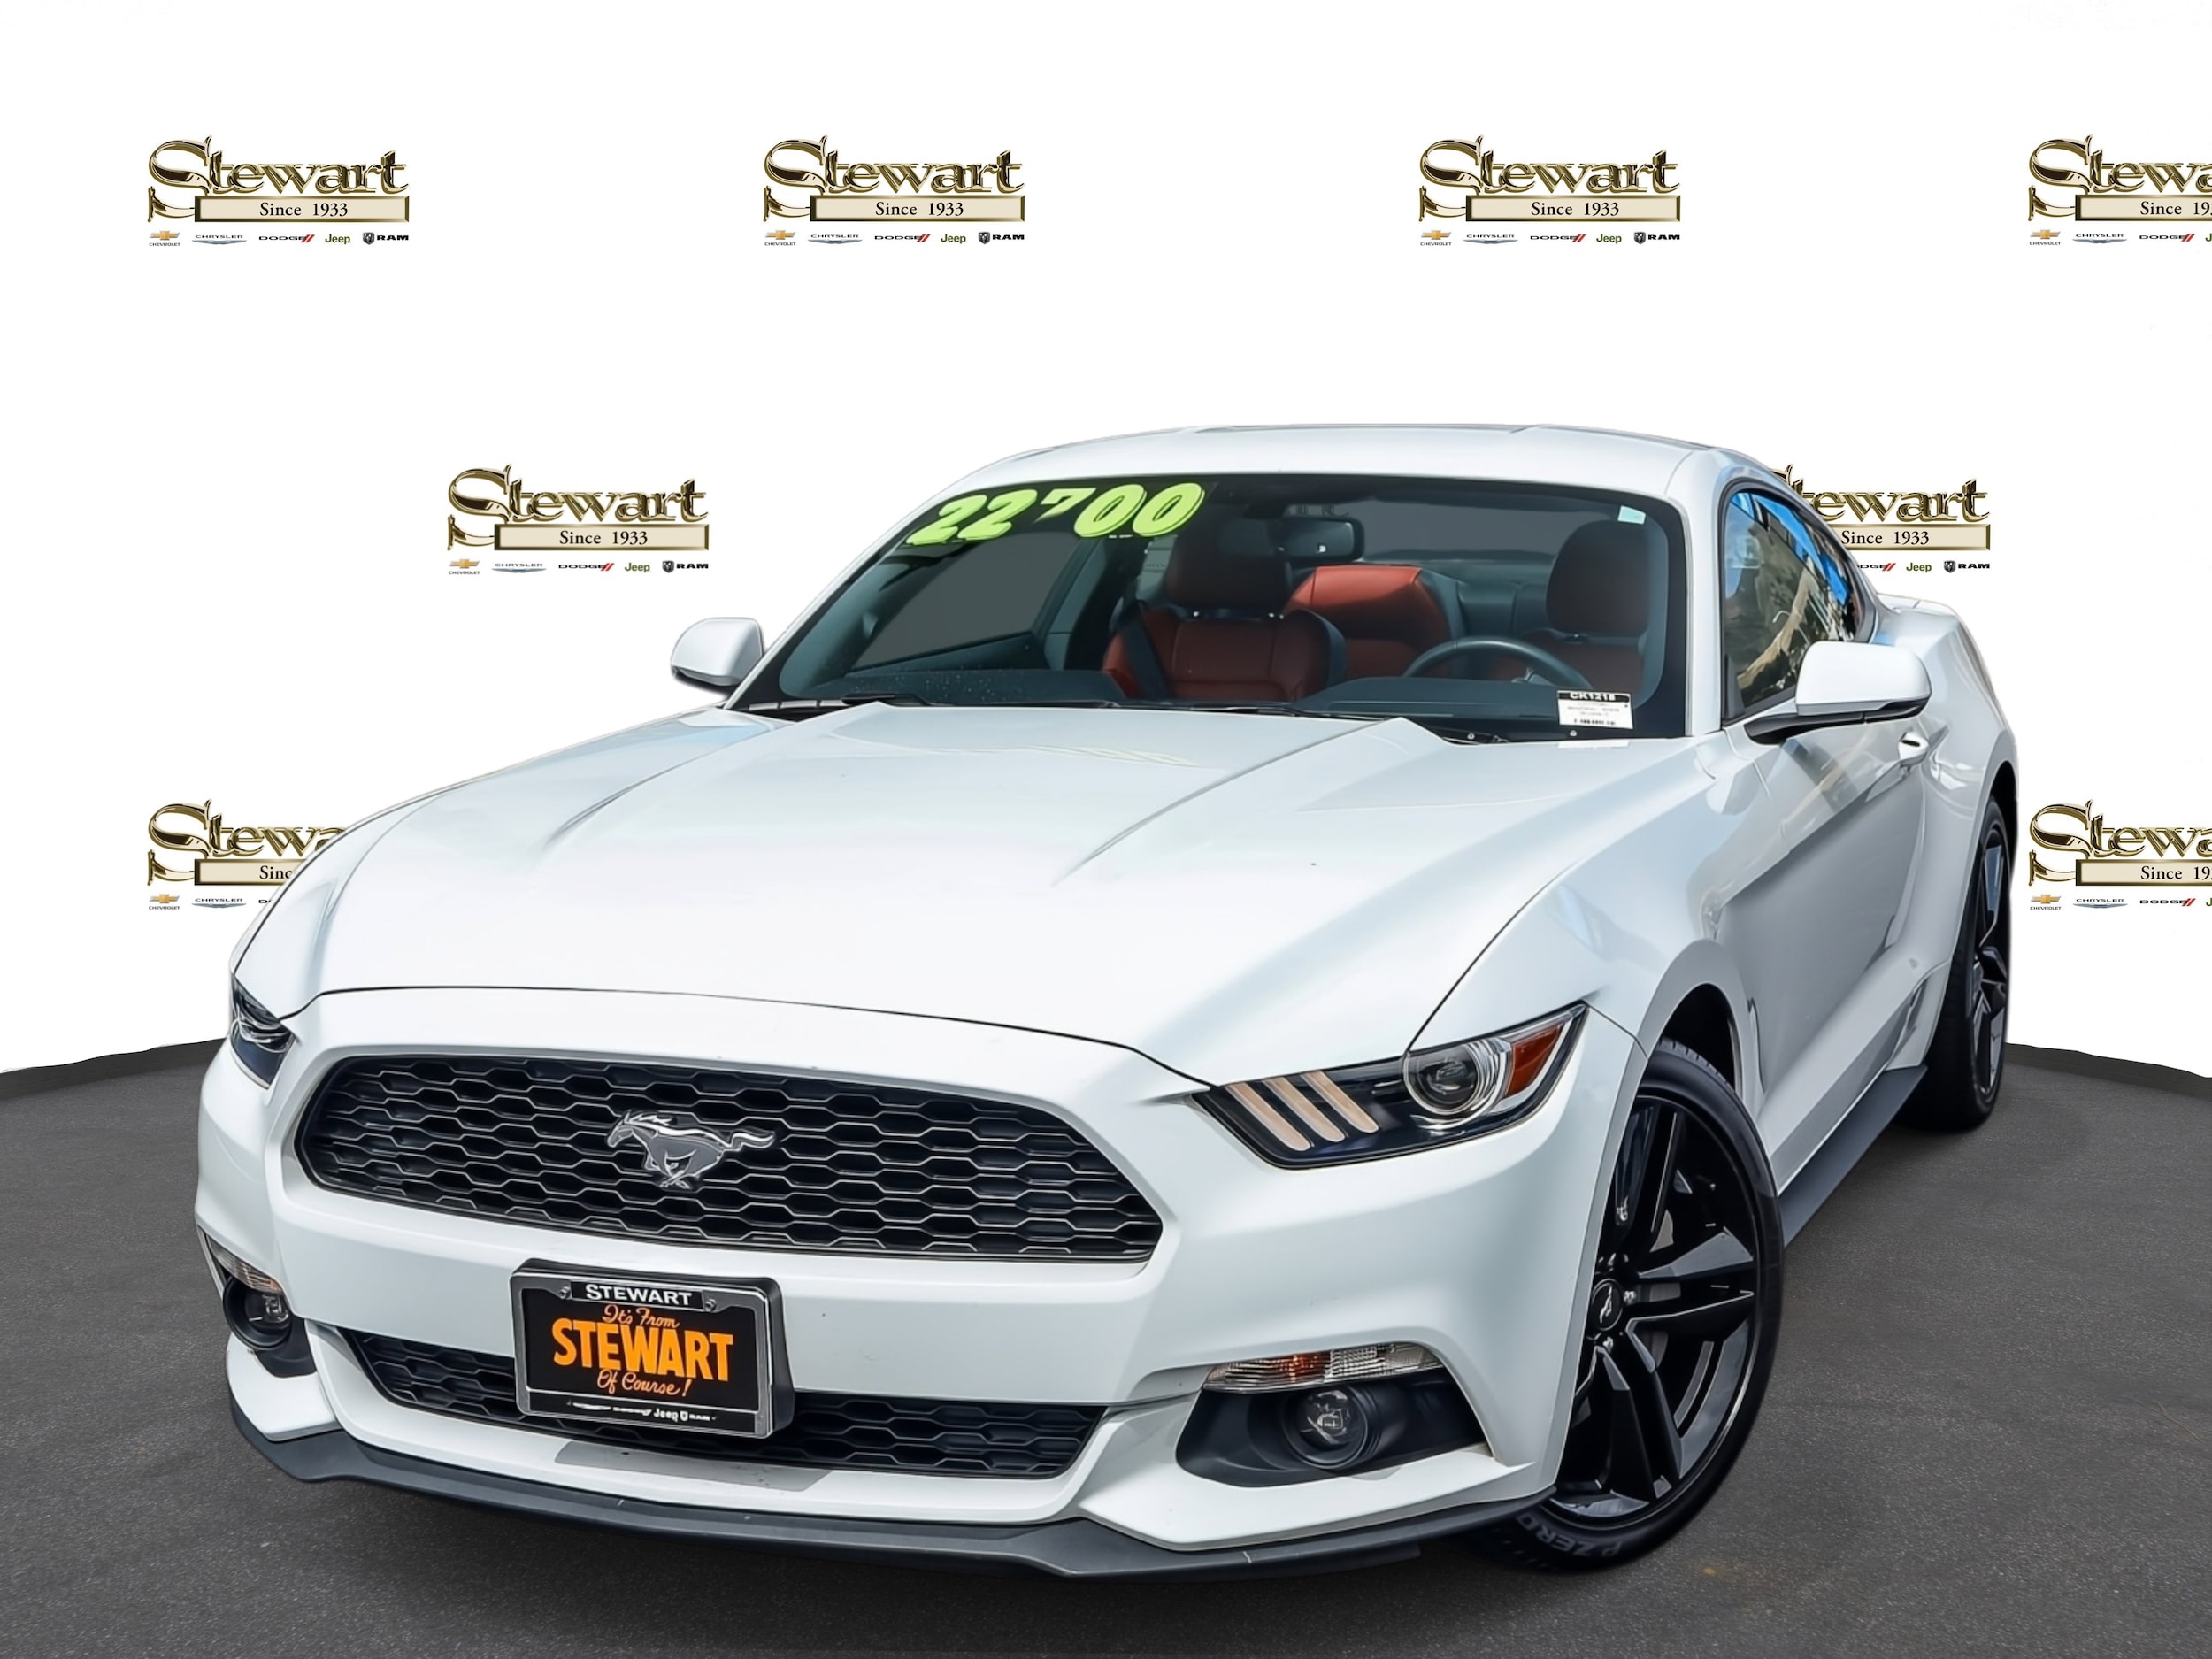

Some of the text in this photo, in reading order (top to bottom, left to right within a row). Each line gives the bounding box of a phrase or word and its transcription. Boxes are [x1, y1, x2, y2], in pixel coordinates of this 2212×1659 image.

[906, 483, 1205, 545] 22700
[586, 1284, 692, 1306] STEWART
[603, 1304, 680, 1329] It's From
[552, 1318, 733, 1381] STEWART
[597, 1369, 617, 1394] Of
[1516, 1512, 1594, 1557] ZERO
